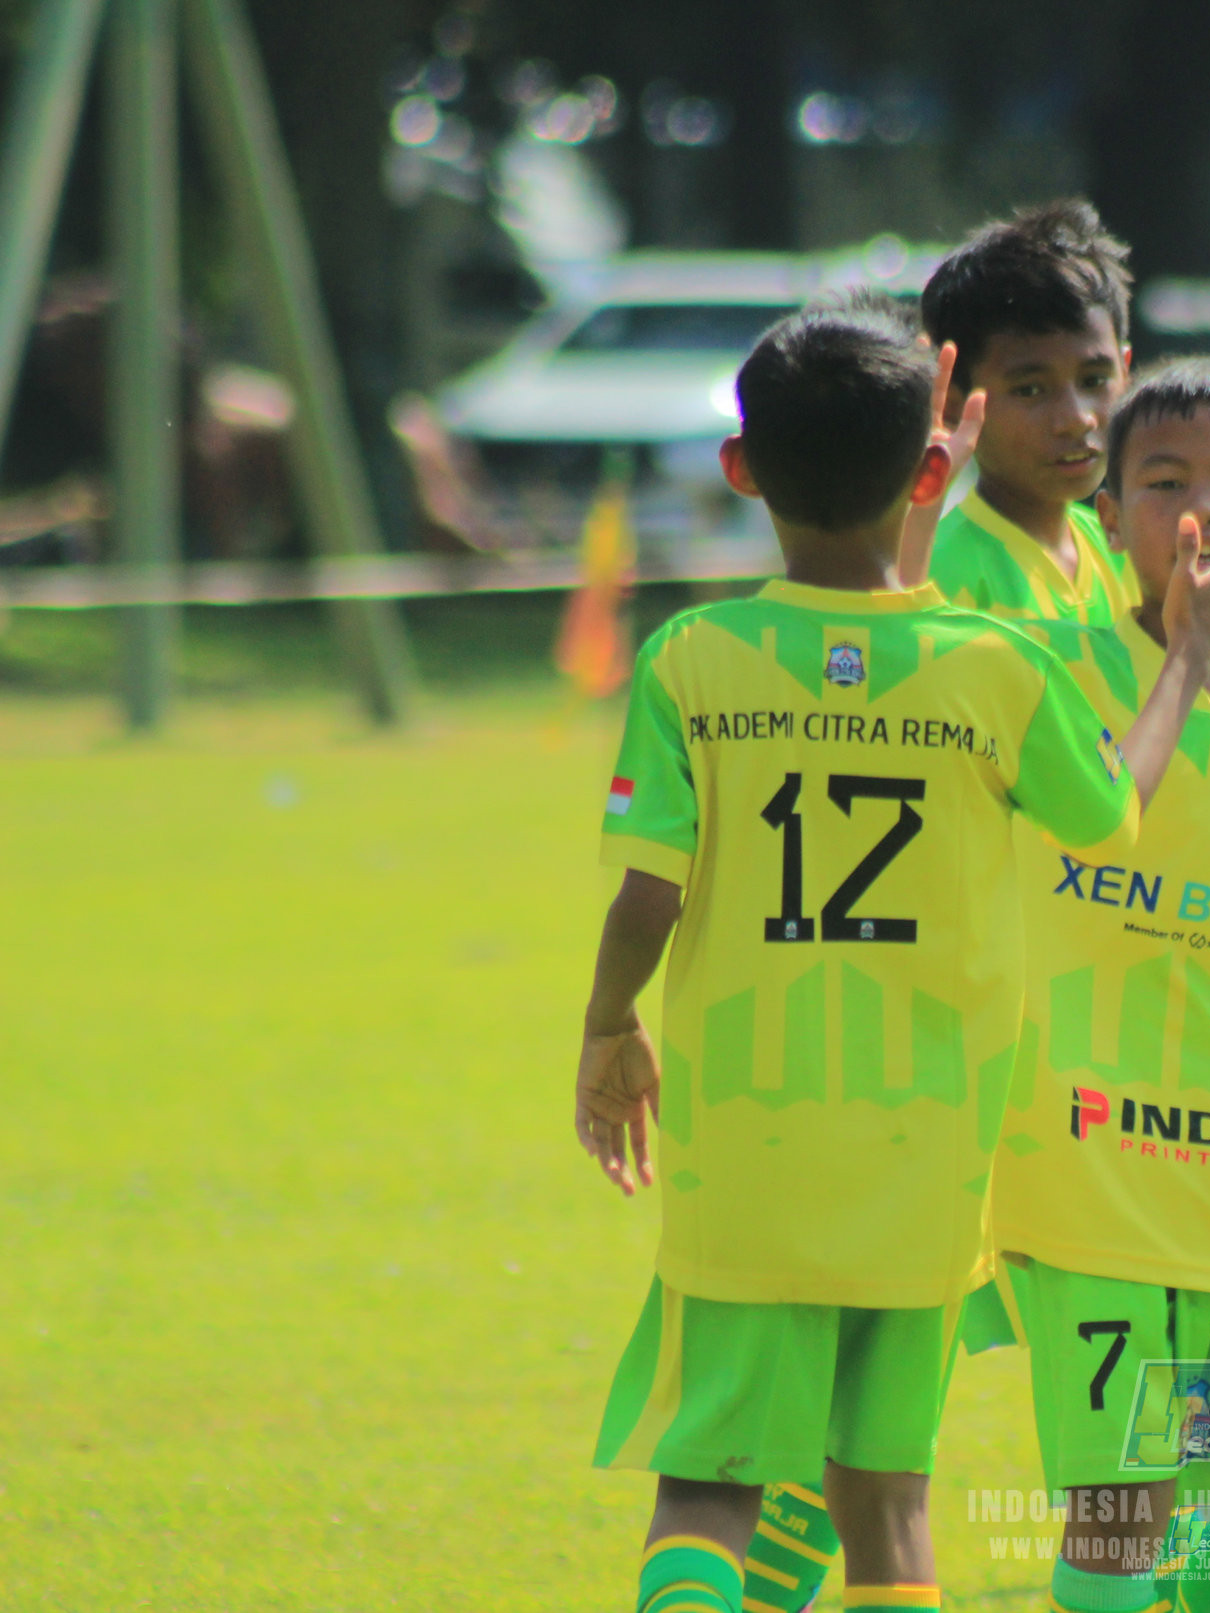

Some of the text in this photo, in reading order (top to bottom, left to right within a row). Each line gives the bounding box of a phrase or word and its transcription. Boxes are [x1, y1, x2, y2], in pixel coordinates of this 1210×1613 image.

[689, 711, 794, 745] AKADEMI
[803, 712, 890, 745] CITRA
[760, 772, 926, 944] 12
[1053, 855, 1163, 914] XEN
[1124, 923, 1168, 940] Member
[1078, 1319, 1132, 1411] 7
